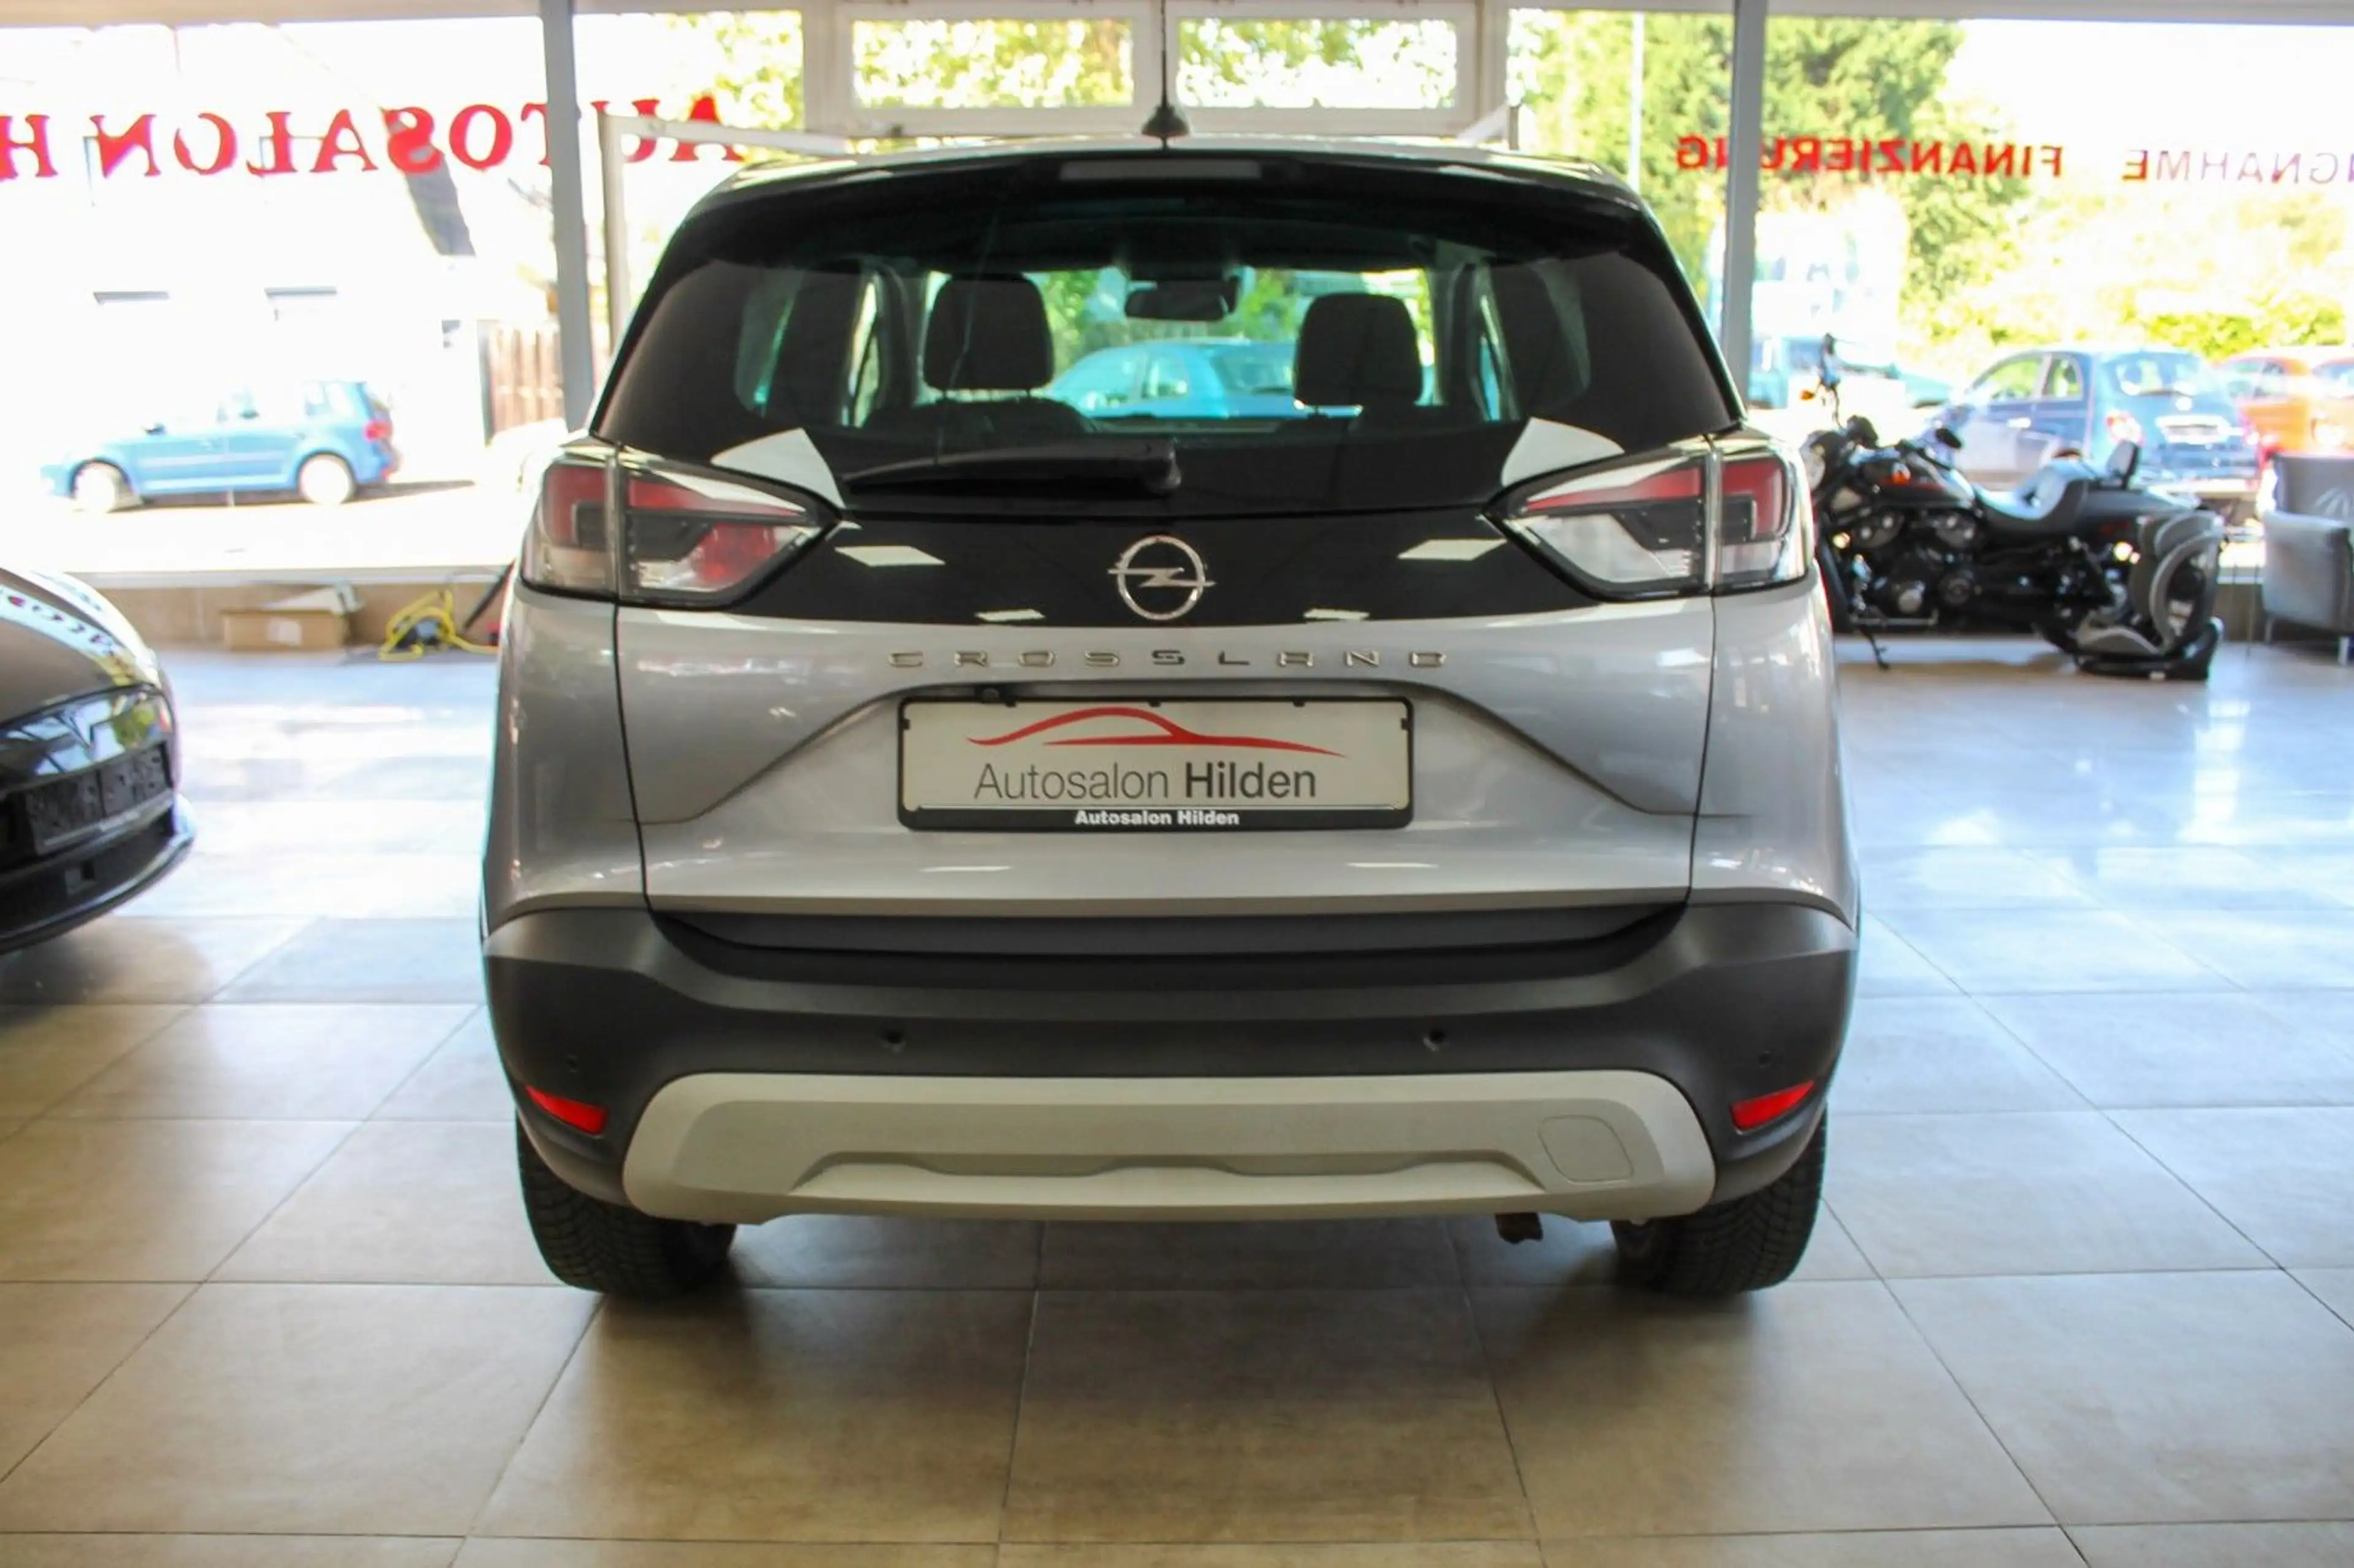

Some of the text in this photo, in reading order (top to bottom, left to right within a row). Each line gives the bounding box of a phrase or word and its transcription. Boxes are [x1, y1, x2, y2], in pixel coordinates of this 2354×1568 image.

[888, 650, 1447, 668] CROSSLAND
[974, 761, 1316, 799] Autosalon Hilden
[1075, 810, 1240, 824] Autosalon Hilden
